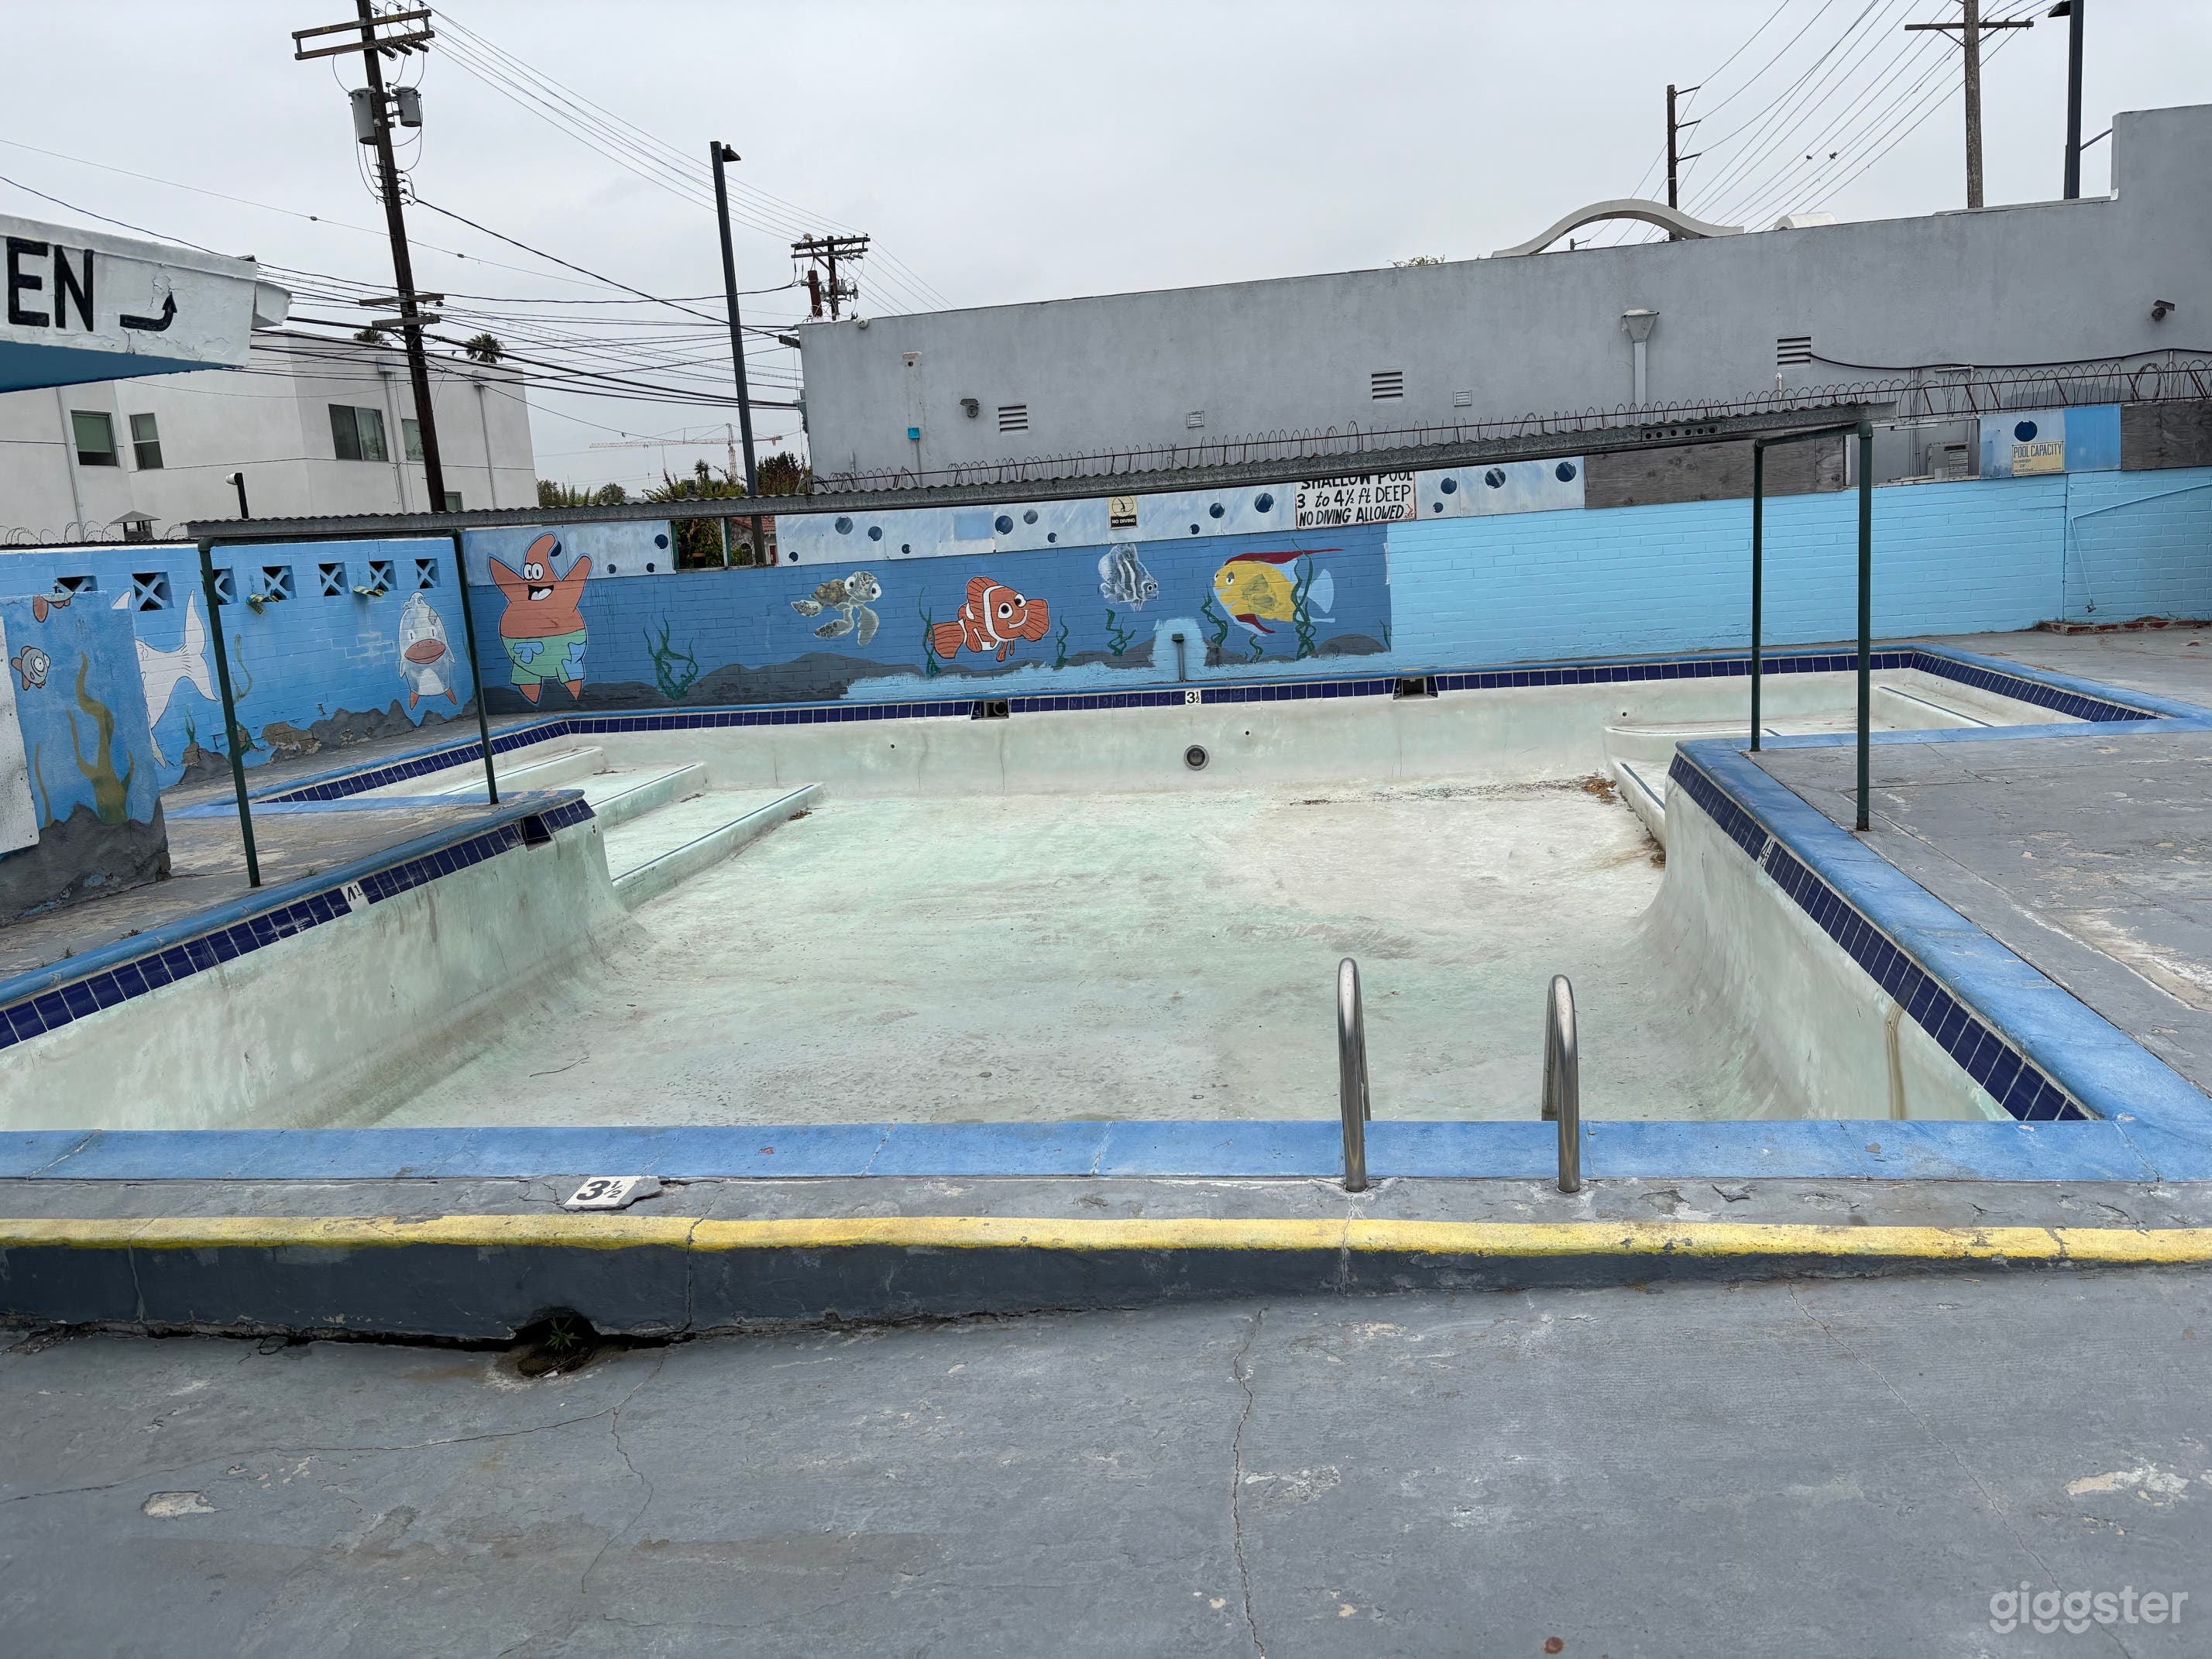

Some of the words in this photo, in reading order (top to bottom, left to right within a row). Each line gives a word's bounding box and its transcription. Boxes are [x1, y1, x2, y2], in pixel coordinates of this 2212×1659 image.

[7, 236, 94, 331] EN
[2014, 445, 2029, 458] POOL
[2031, 443, 2063, 456] CAPACITY
[1297, 493, 1306, 508] 3
[1315, 491, 1330, 507] to
[1358, 488, 1371, 504] ft
[1376, 485, 1411, 503] DEEP
[1299, 511, 1314, 527] NO
[1315, 507, 1352, 525] DIVING
[1355, 504, 1404, 523] ALLOWED
